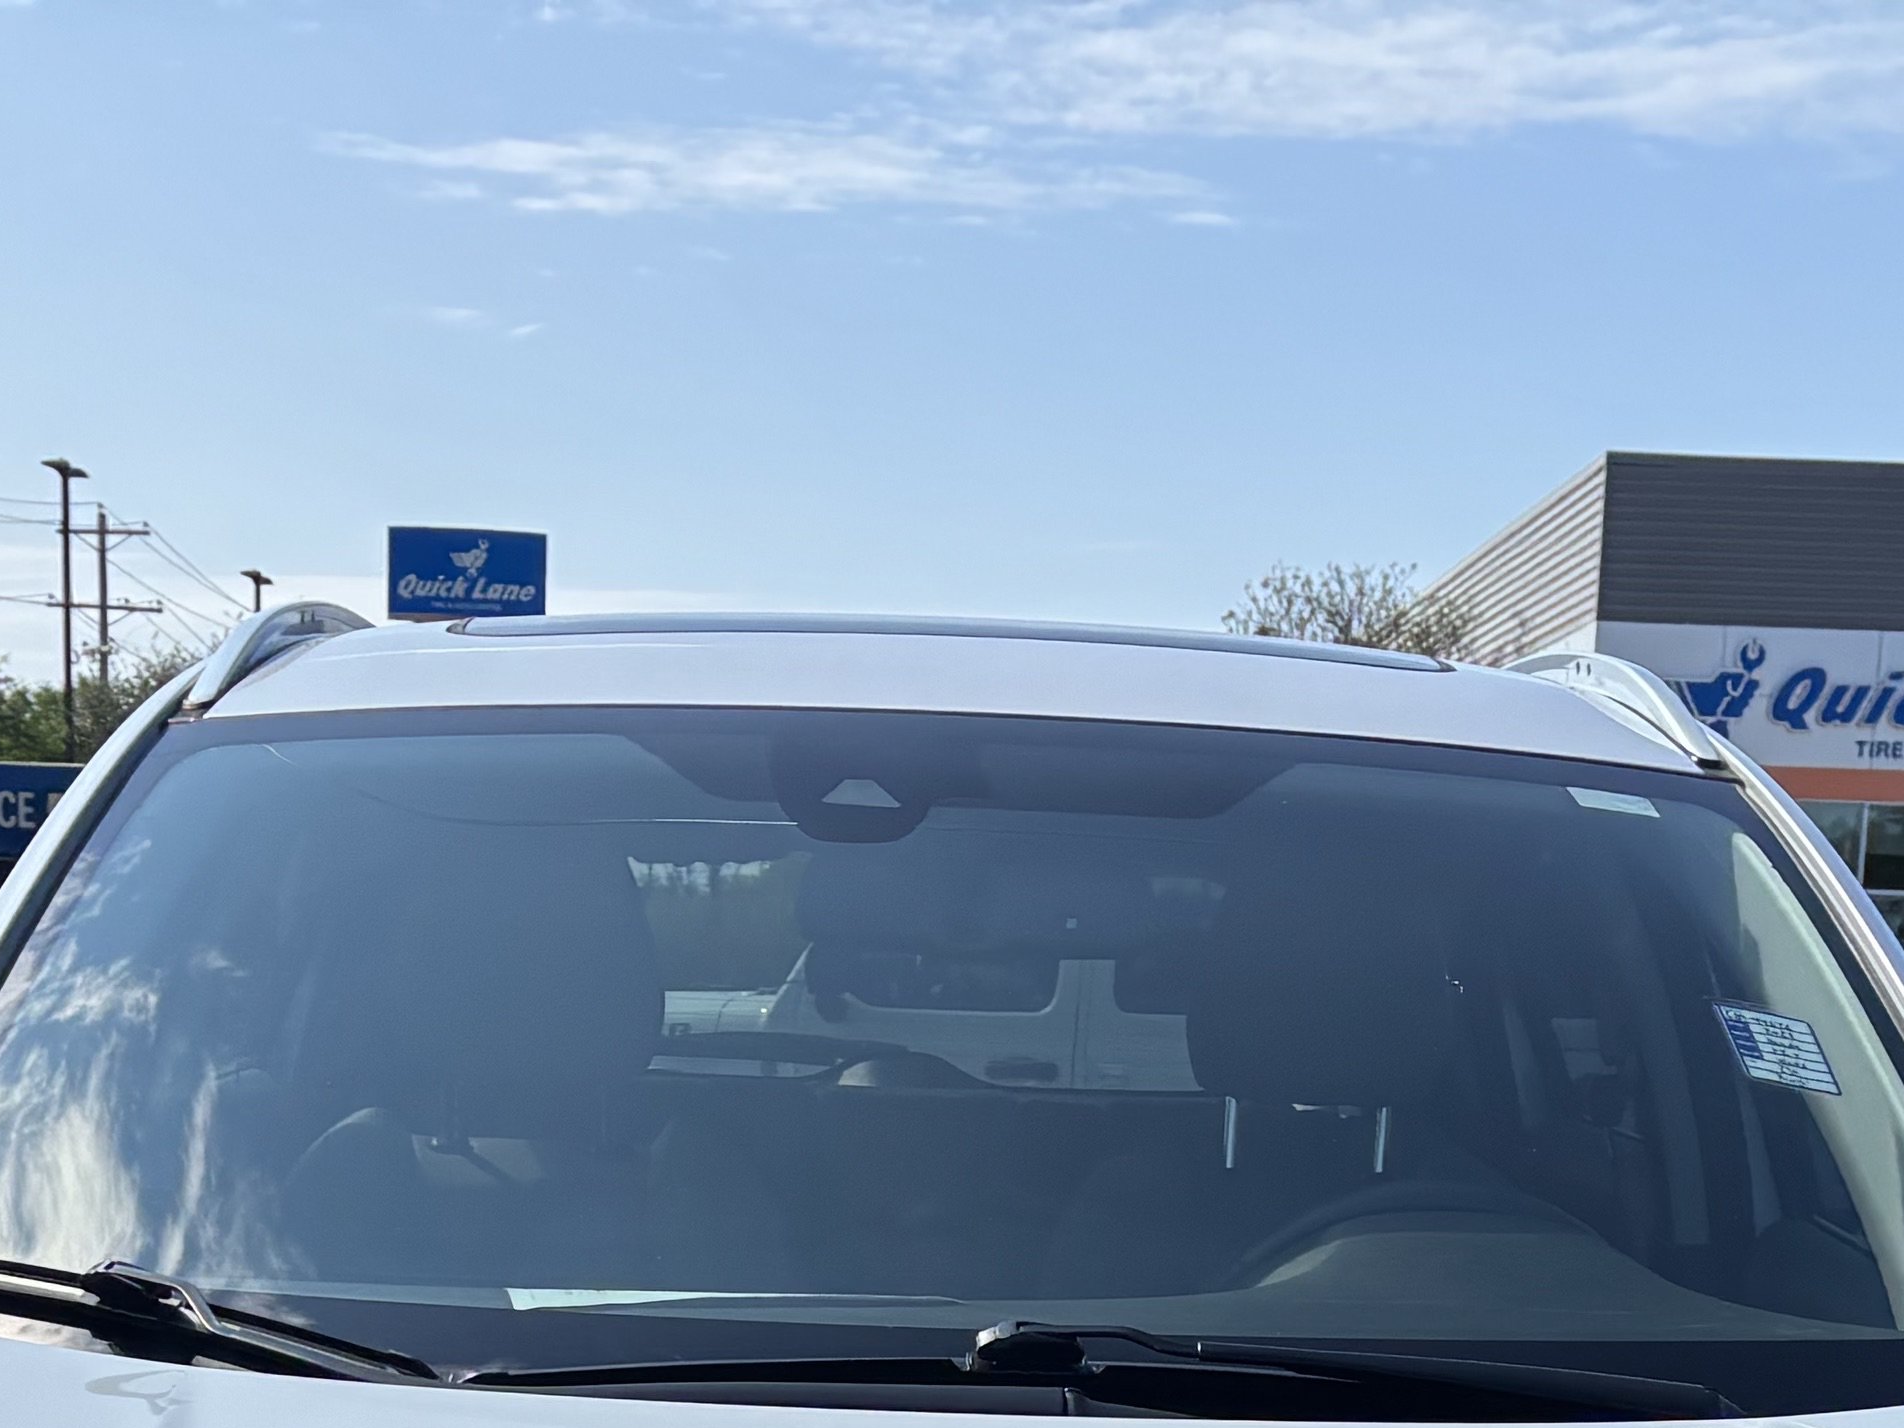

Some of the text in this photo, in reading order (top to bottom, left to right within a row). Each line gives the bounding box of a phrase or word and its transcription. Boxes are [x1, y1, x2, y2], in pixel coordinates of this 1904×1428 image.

[397, 573, 537, 602] Quick Lane
[1855, 740, 1903, 760] TIRE
